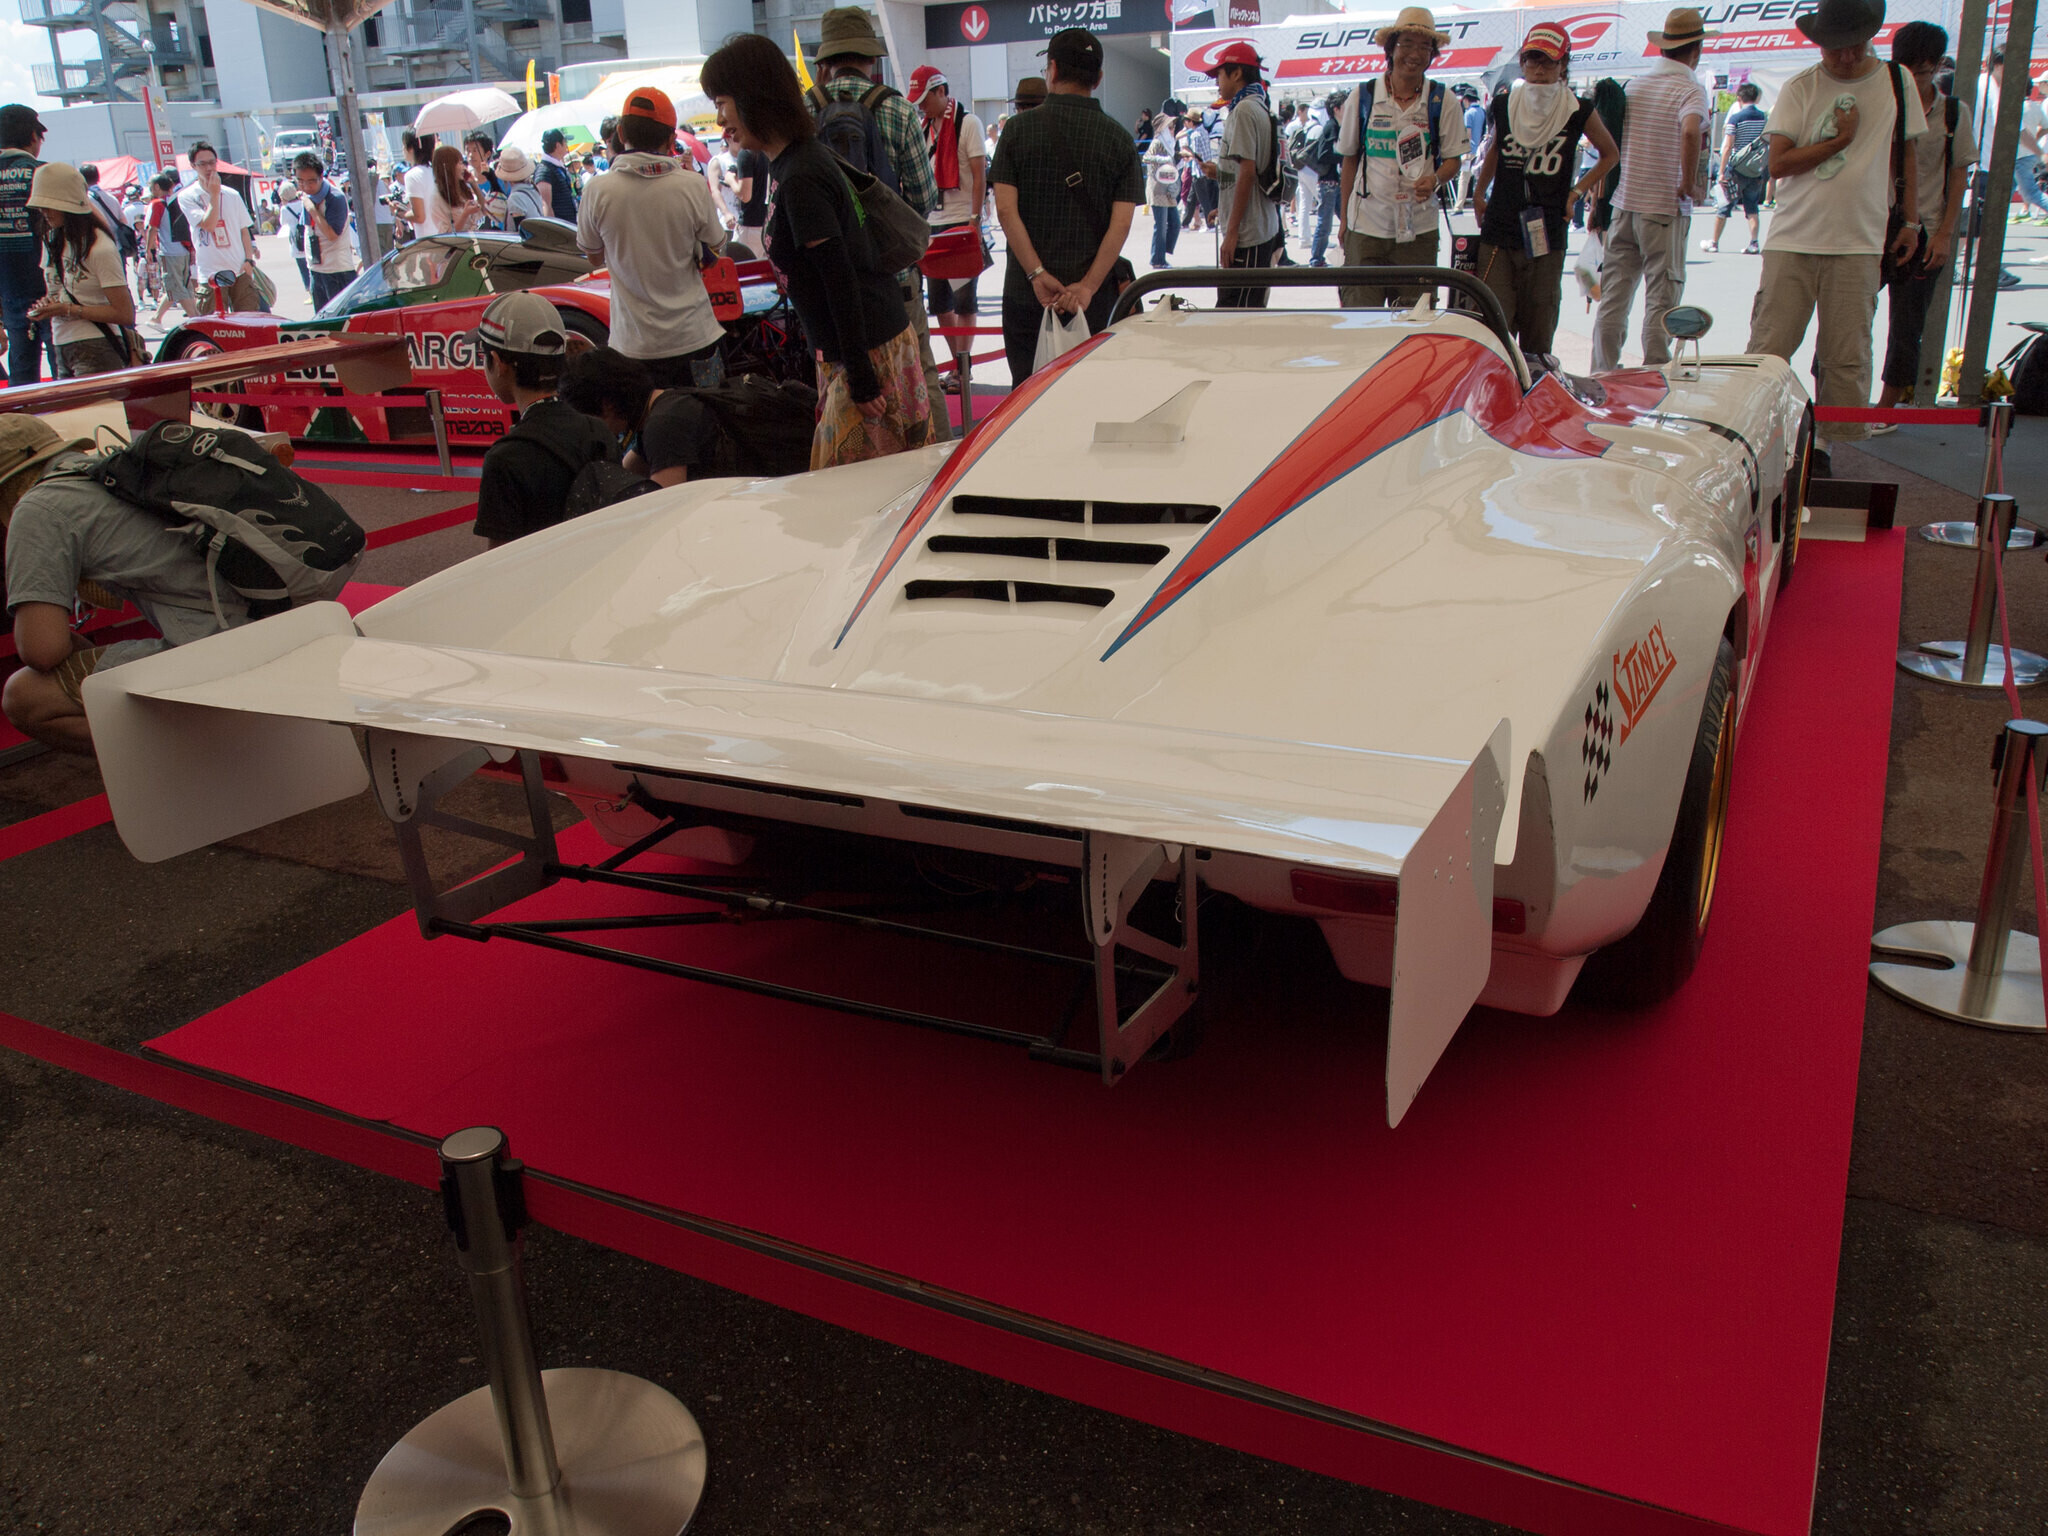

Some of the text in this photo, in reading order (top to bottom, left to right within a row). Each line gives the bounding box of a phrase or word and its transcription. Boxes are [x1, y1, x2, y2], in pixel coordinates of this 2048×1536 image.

[1029, 0, 1122, 24] パドック方面
[1045, 26, 1053, 35] to
[1089, 22, 1108, 31] Area
[1703, 34, 1795, 50] FFICIAL
[213, 329, 245, 338] ADVAN
[1612, 618, 1677, 748] STANLEY
